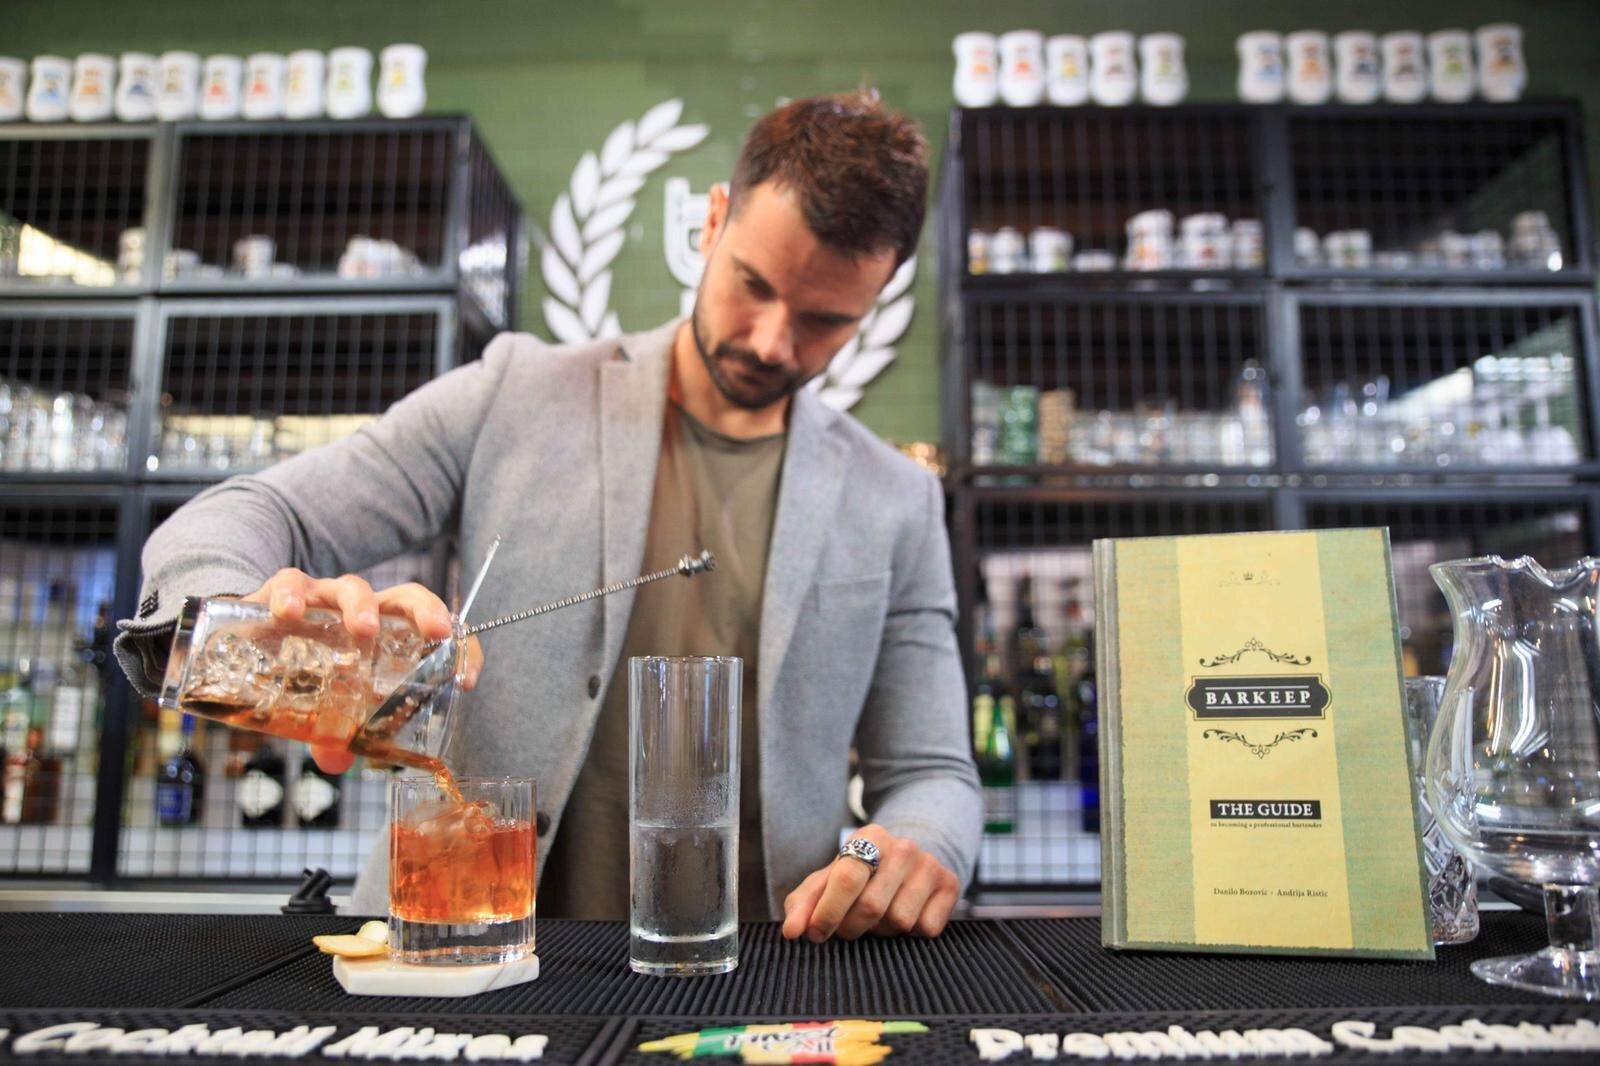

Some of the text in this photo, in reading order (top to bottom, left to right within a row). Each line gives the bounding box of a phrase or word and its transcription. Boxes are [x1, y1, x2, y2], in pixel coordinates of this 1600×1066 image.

[1206, 690, 1310, 705] BARKEEP
[1217, 803, 1313, 816] THE GUIDE
[1218, 821, 1247, 829] becoming
[1253, 821, 1291, 829] professional
[1292, 821, 1322, 829] bartender
[1213, 887, 1238, 895] Danilo
[1277, 888, 1305, 898] Andrija
[969, 1024, 1335, 1060] Premium
